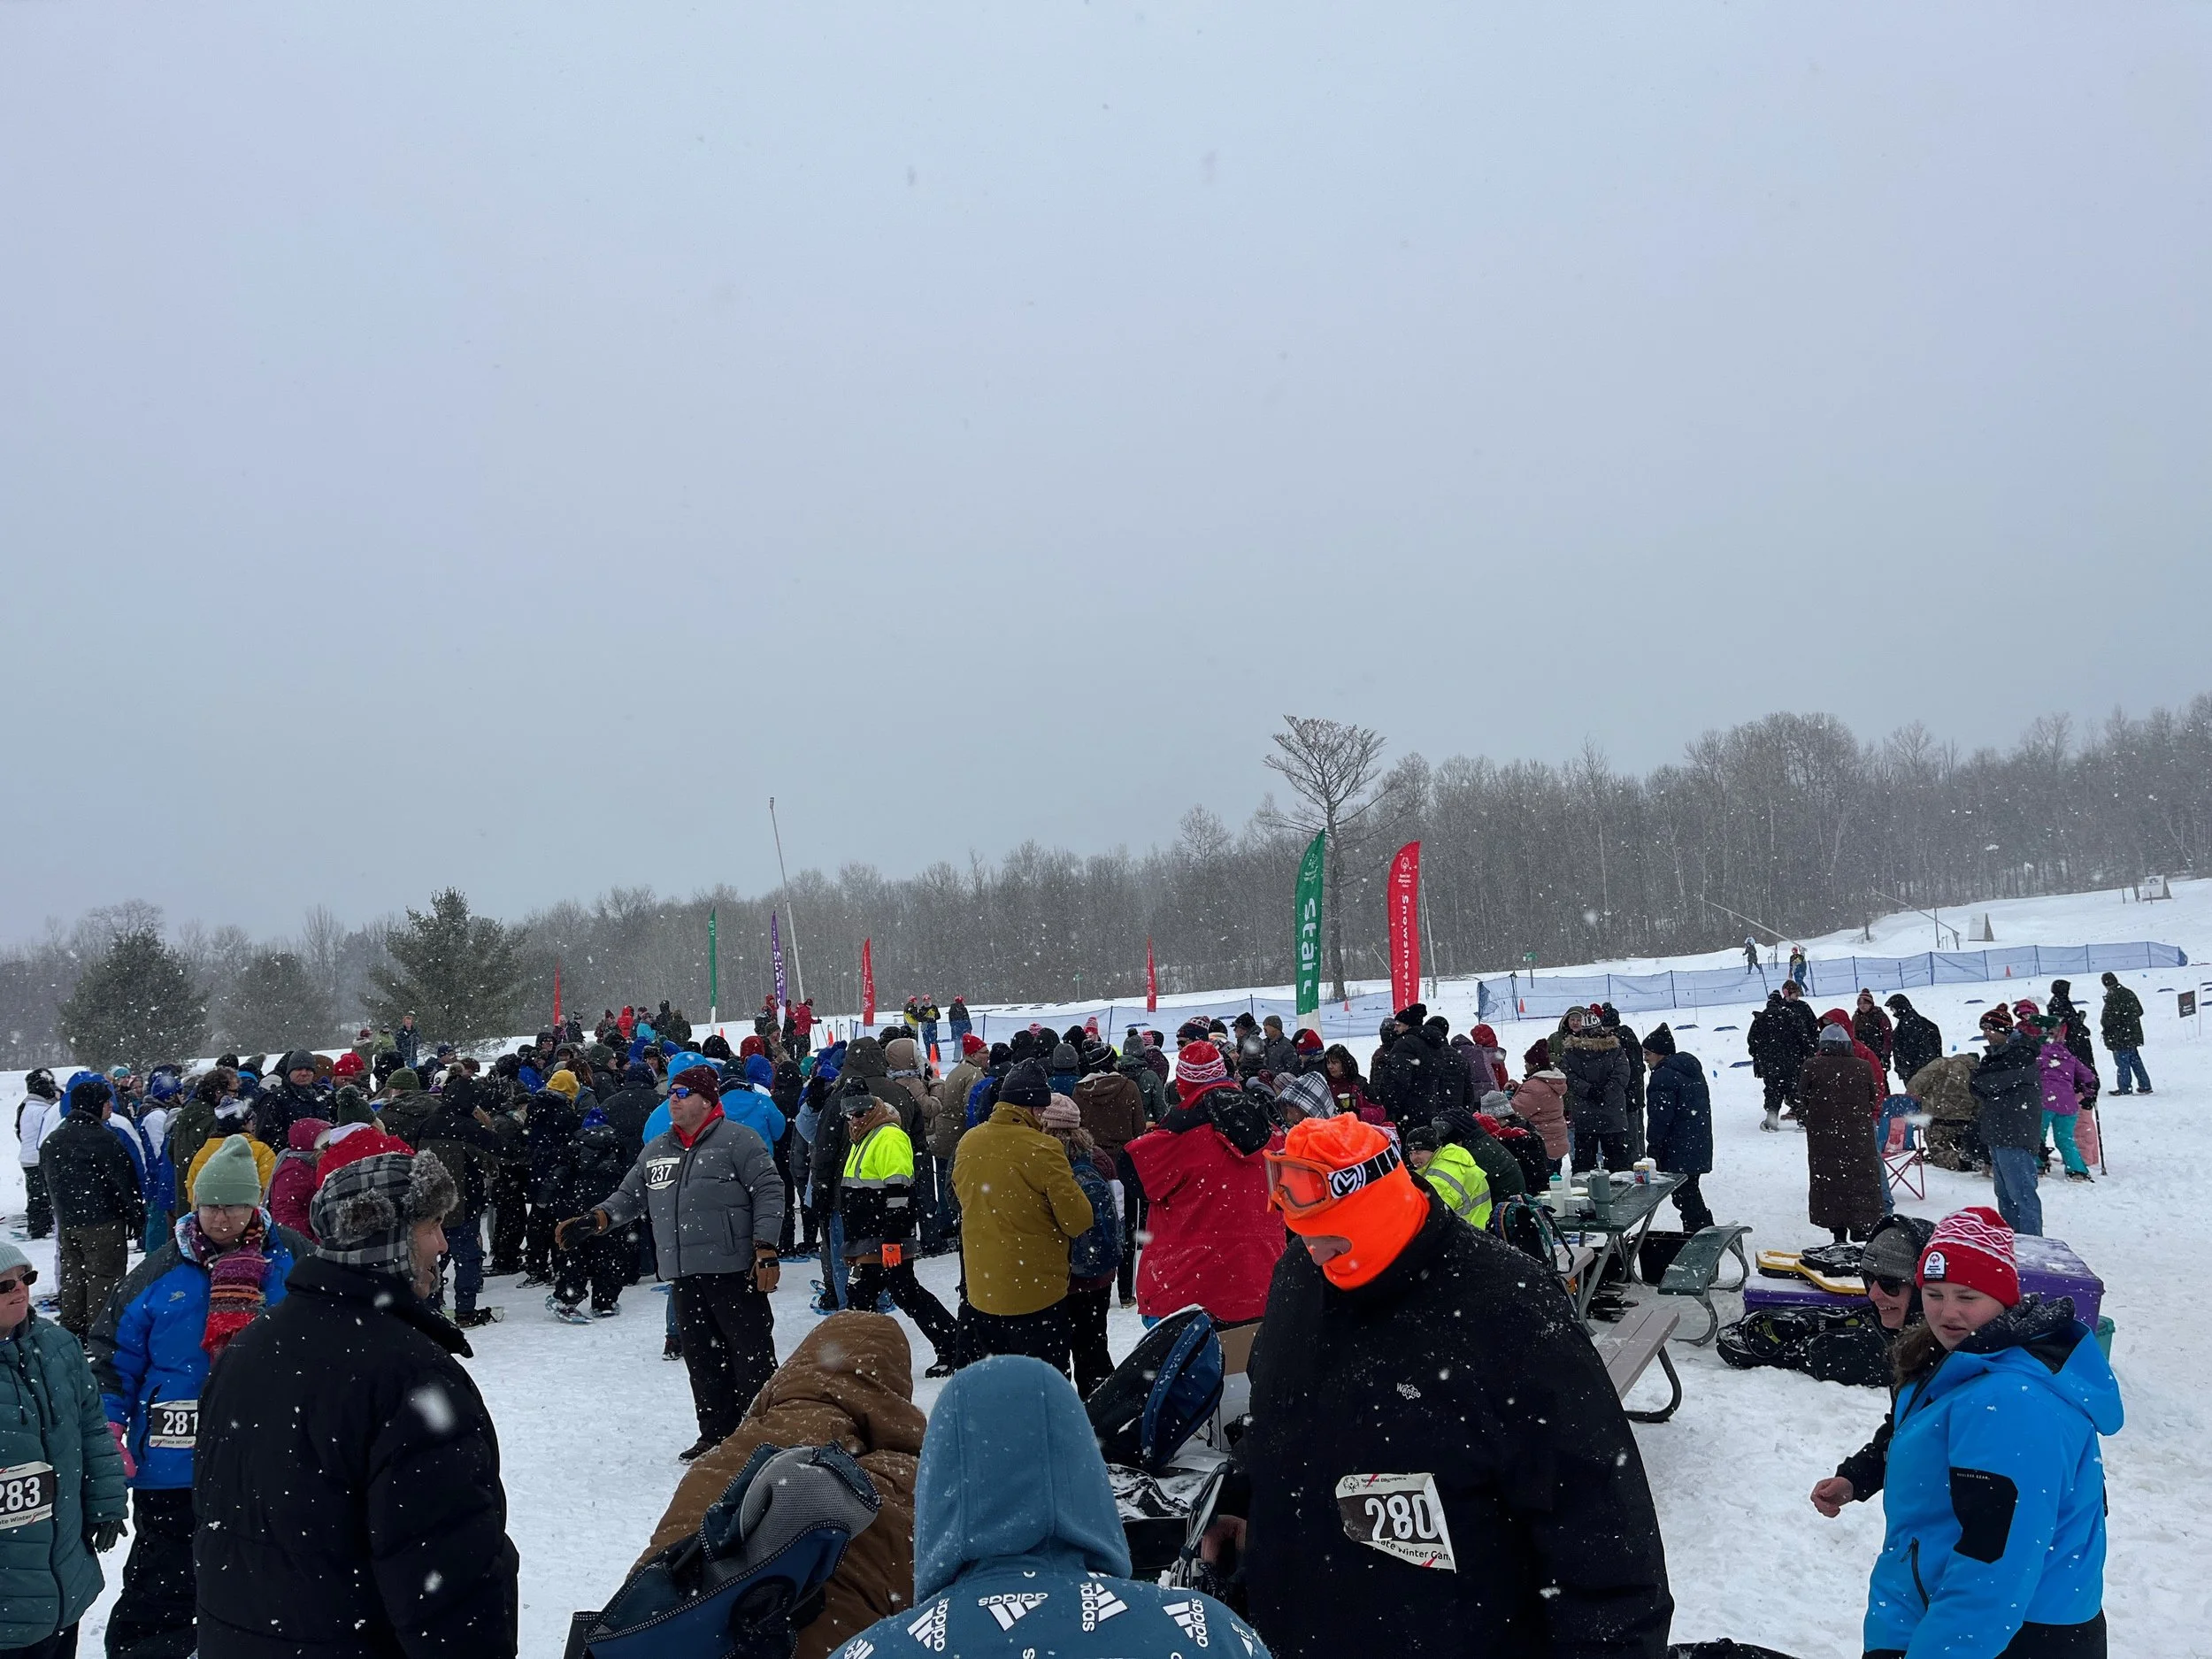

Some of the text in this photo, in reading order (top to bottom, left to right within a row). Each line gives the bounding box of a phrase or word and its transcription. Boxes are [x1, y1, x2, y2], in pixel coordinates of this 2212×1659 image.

[650, 1164, 672, 1184] 237
[162, 1410, 199, 1435] 281
[1364, 1494, 1440, 1541] 280
[1431, 1550, 1452, 1562] Gam
[978, 1593, 1048, 1607] adidas
[1080, 1582, 1099, 1632] adidas
[932, 1597, 950, 1653] adidas
[1189, 1597, 1209, 1648] adidas
